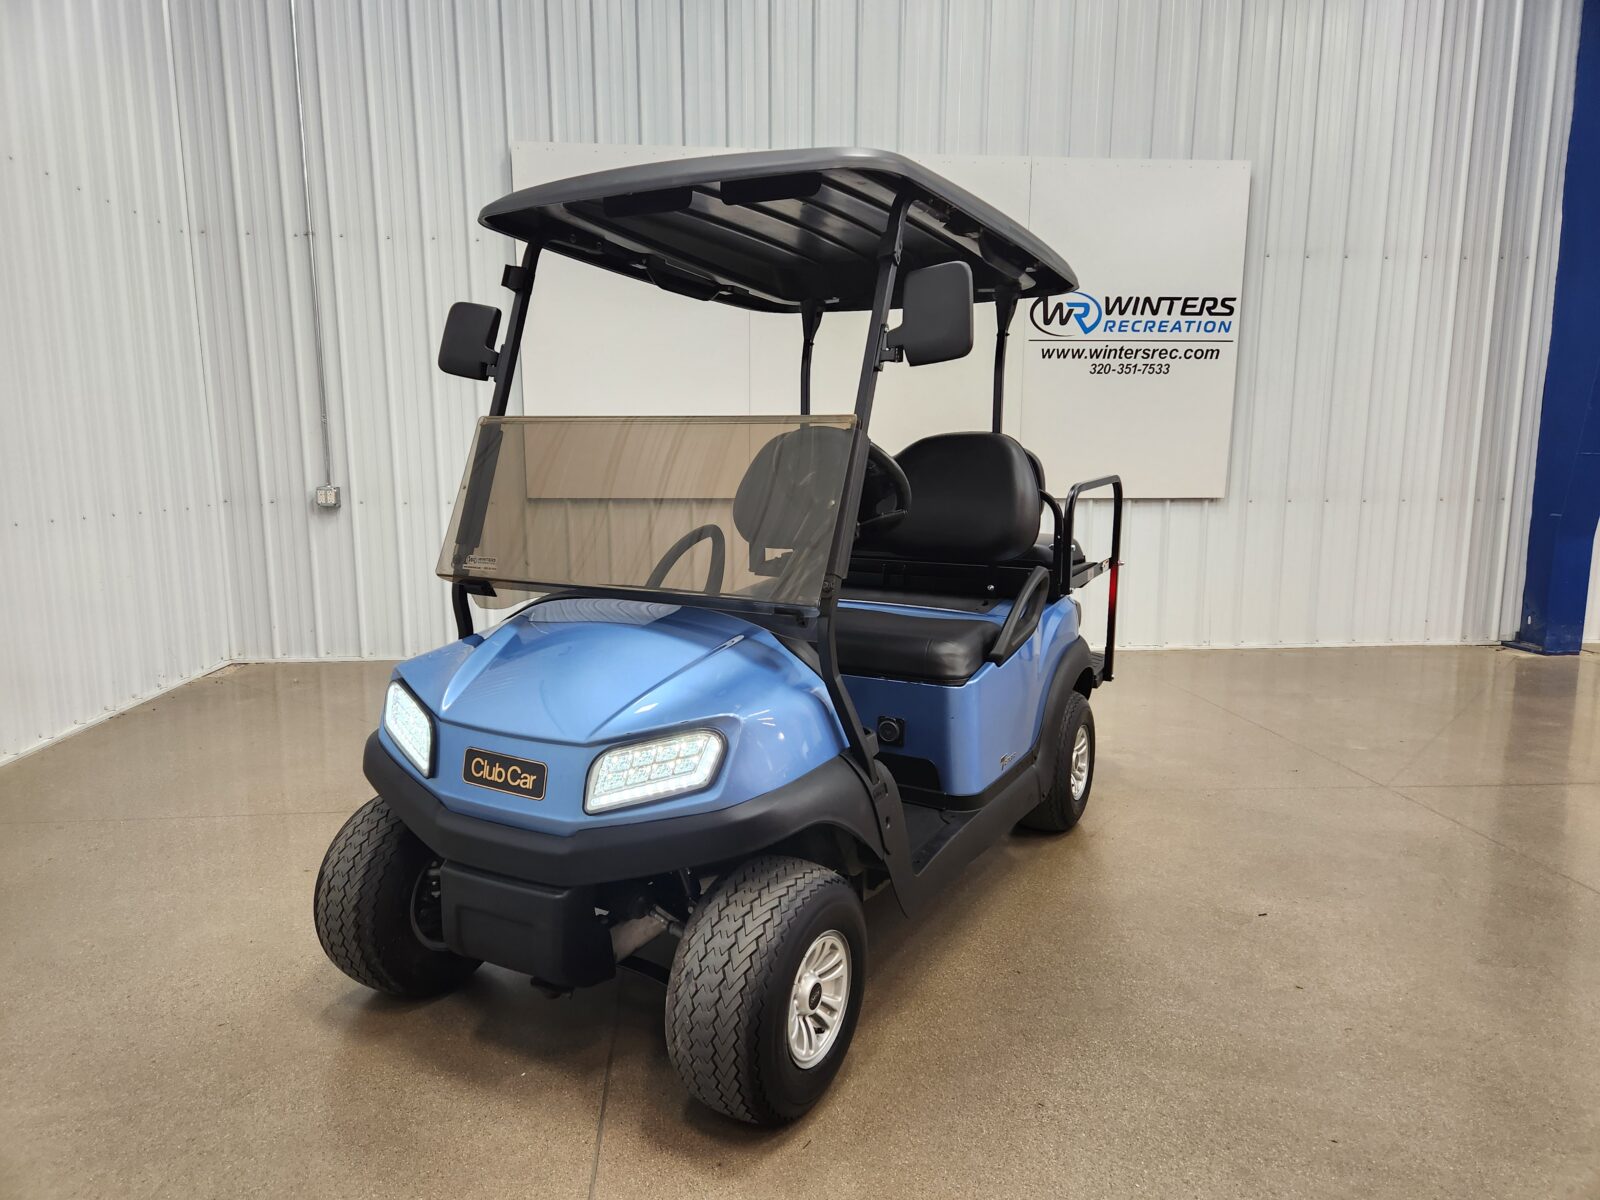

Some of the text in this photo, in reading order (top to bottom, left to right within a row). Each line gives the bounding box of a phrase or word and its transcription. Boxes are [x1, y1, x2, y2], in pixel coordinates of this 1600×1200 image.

[1104, 296, 1237, 316] WINTERS
[1103, 320, 1232, 333] RECREATION
[1041, 345, 1220, 360] www.wintersrec.com
[1089, 363, 1171, 375] 320-351-7533
[471, 757, 537, 790] Club Car
